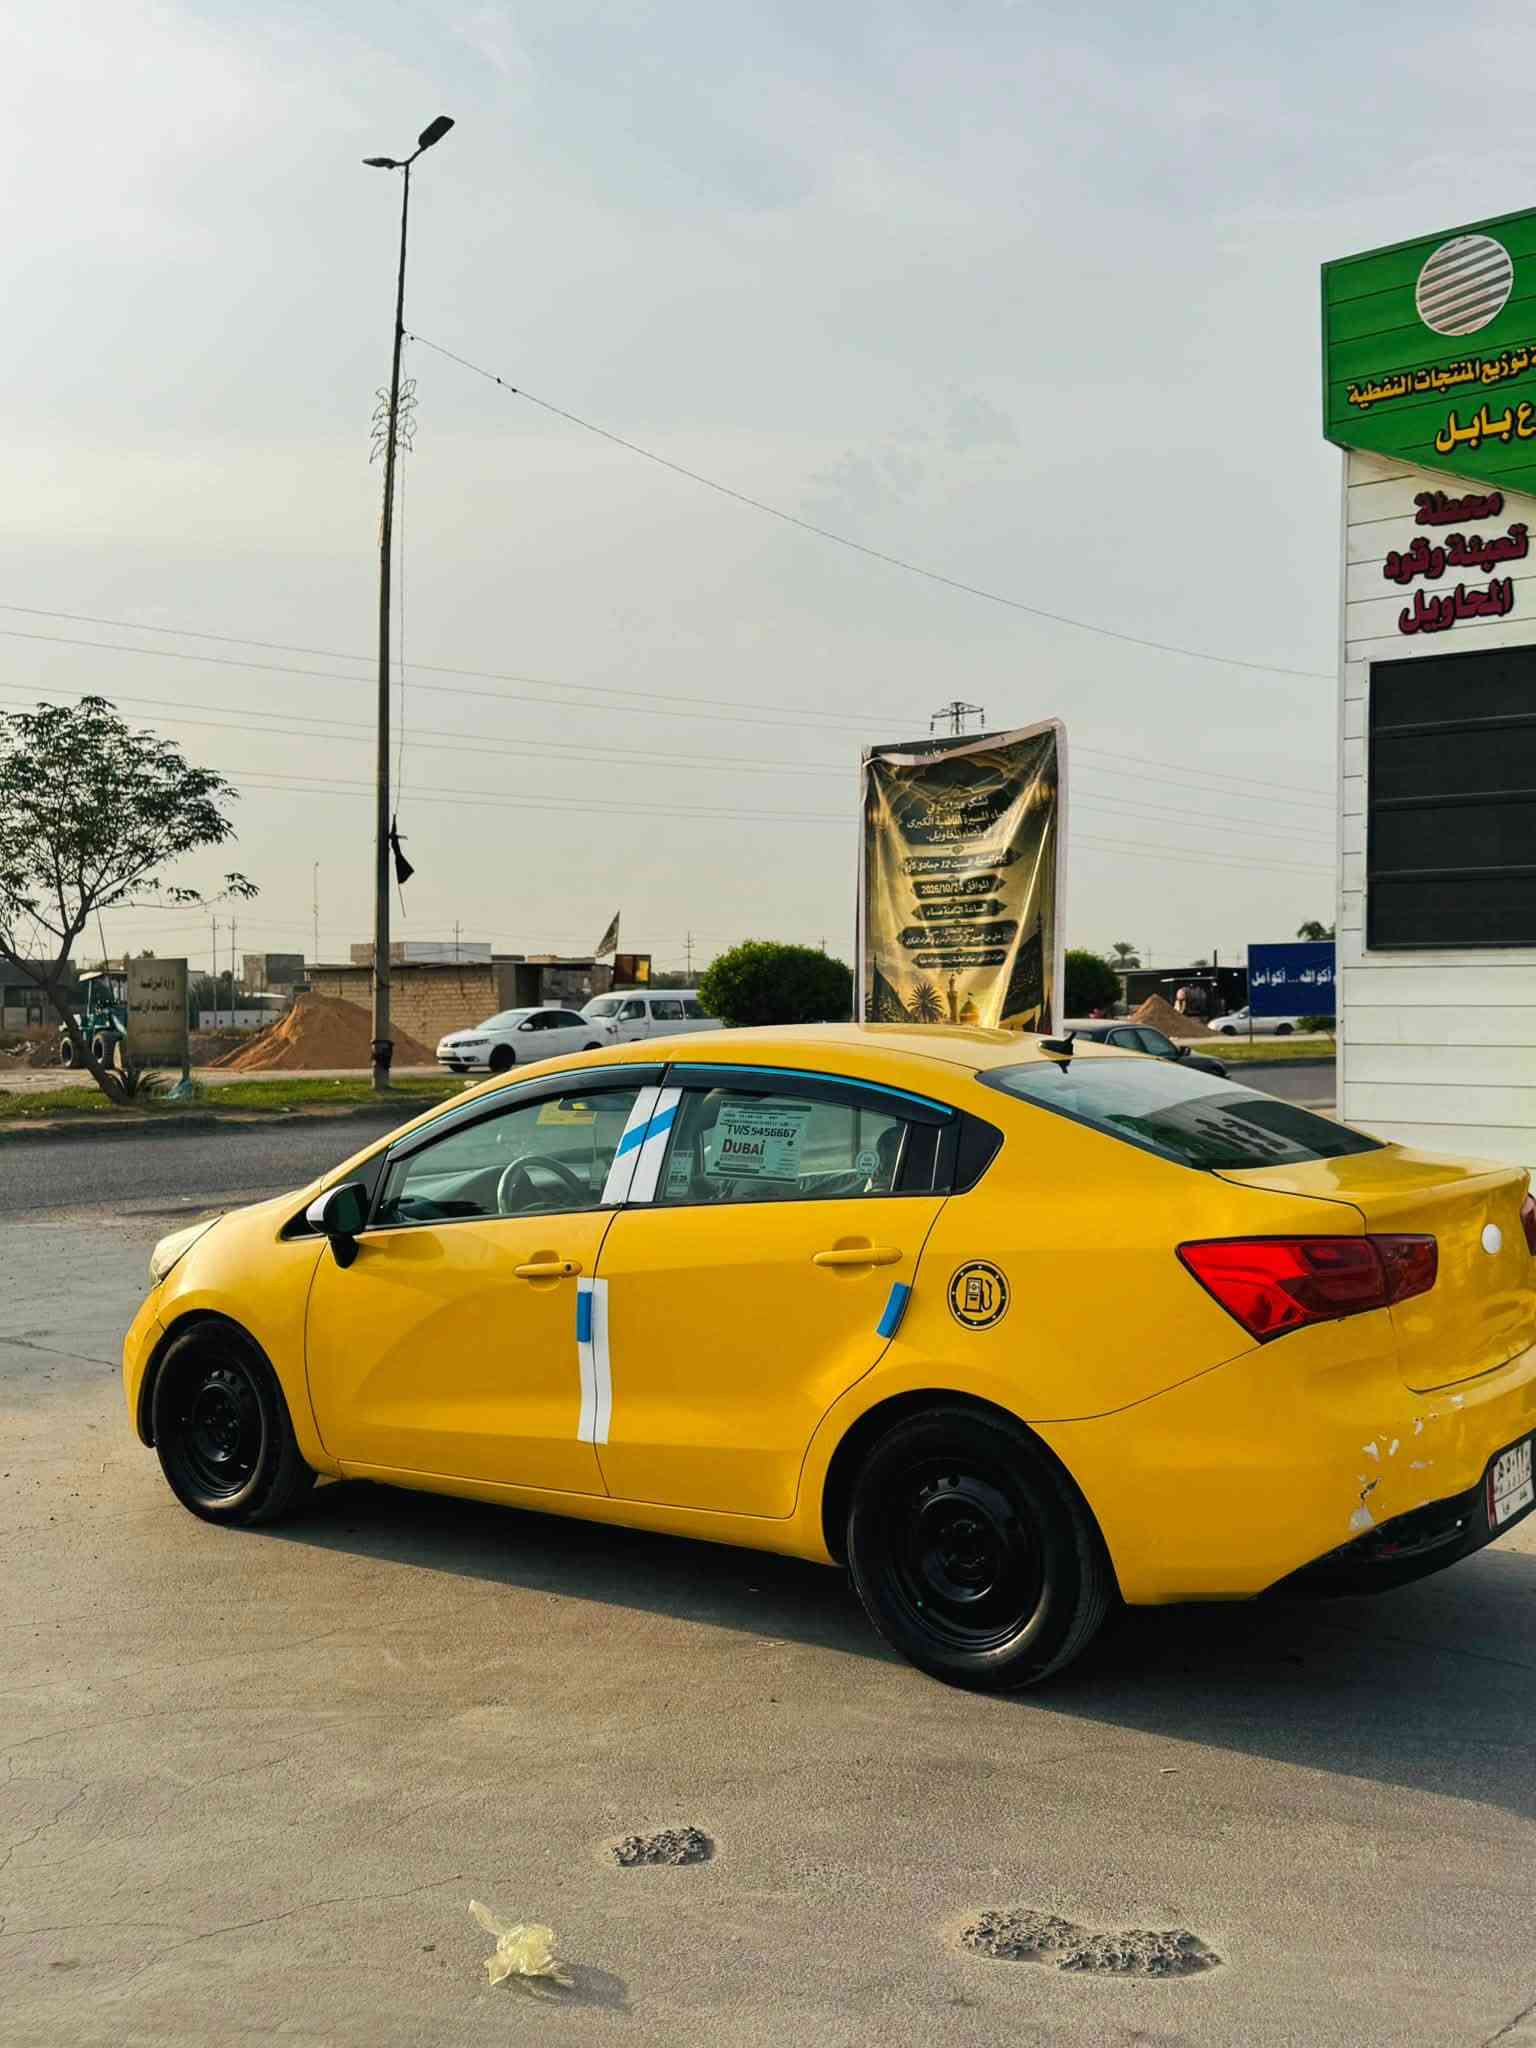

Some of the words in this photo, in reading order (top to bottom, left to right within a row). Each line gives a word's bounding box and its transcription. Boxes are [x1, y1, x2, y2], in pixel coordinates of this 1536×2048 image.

[1414, 359, 1481, 392] المنتجات
[1481, 347, 1529, 384] توزيع
[1346, 374, 1412, 409] النفطية
[1436, 404, 1512, 452] بابل
[1414, 490, 1504, 526] محطة
[1383, 536, 1447, 585] وقود
[1445, 523, 1529, 573] تعبئة
[1398, 577, 1514, 635] المحاويل
